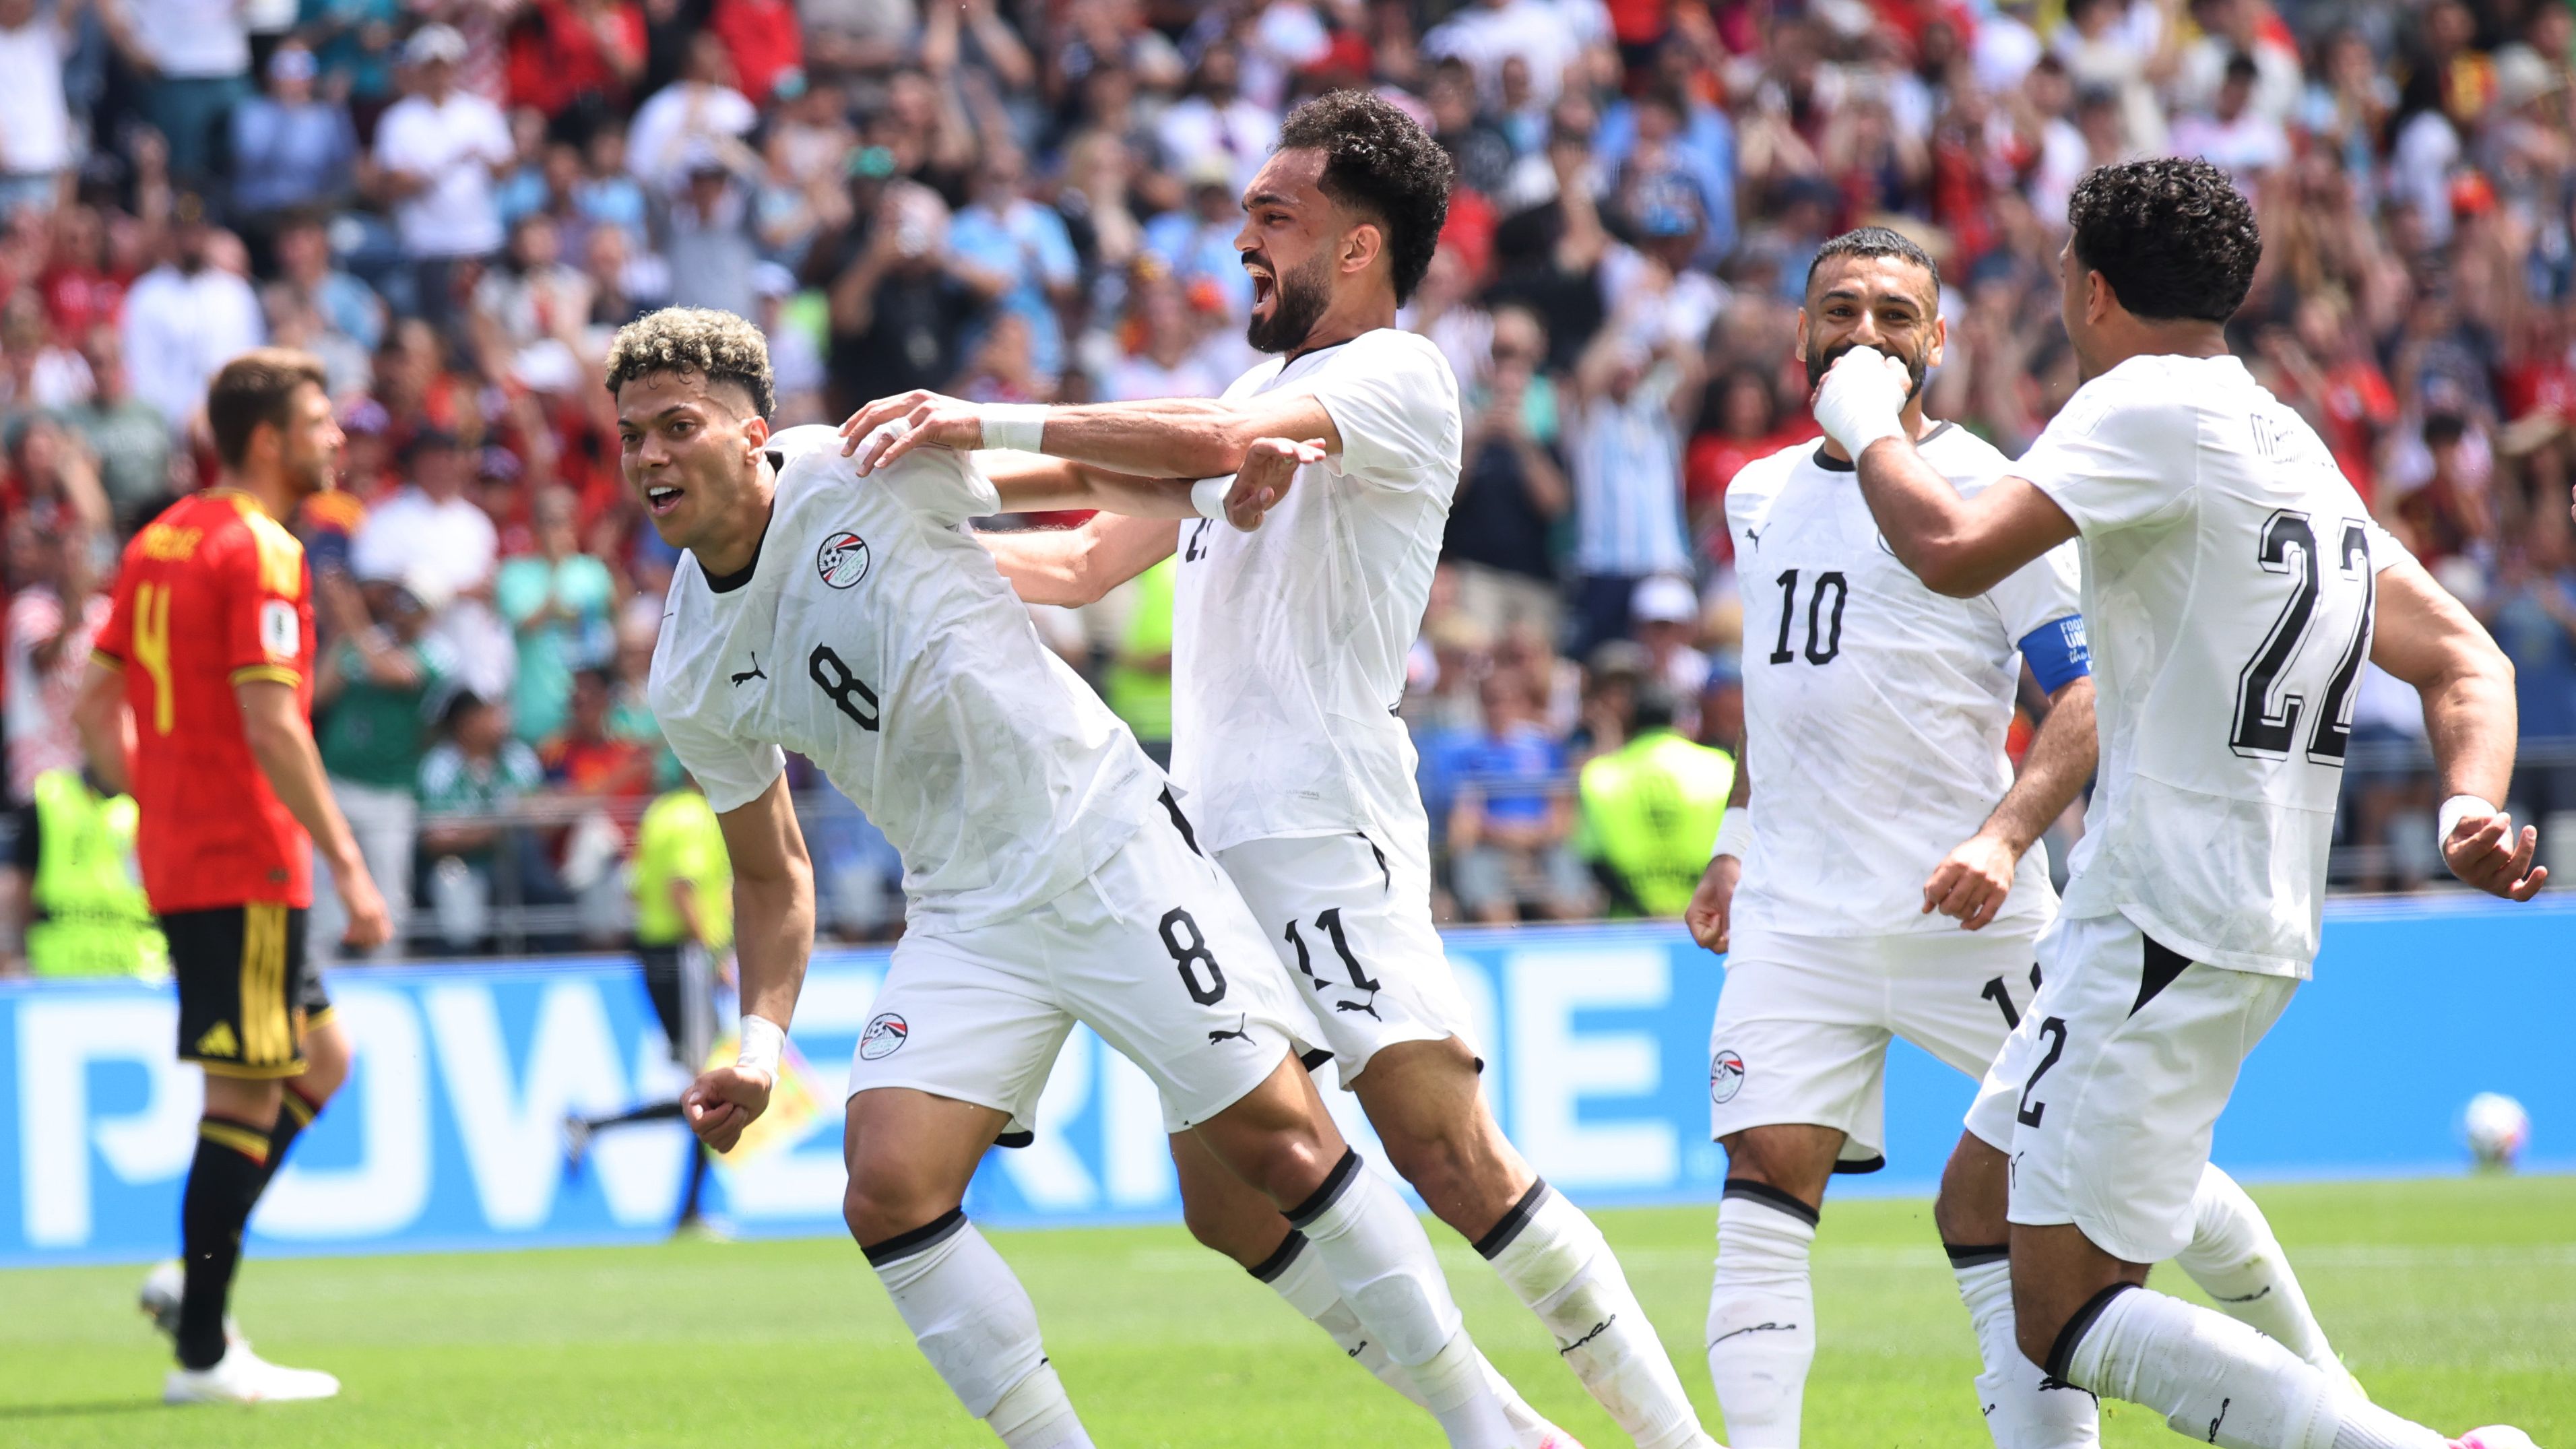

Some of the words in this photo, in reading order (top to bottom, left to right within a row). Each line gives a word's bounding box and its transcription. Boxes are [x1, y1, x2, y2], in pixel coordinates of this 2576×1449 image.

[133, 581, 174, 736] 4
[1770, 569, 1848, 666] 10
[2064, 630, 2088, 648] UN
[2229, 508, 2376, 768] 22
[809, 641, 879, 732] 8
[1158, 905, 1227, 1006] 8
[1285, 907, 1381, 992] 11
[1981, 962, 2042, 1031] 1
